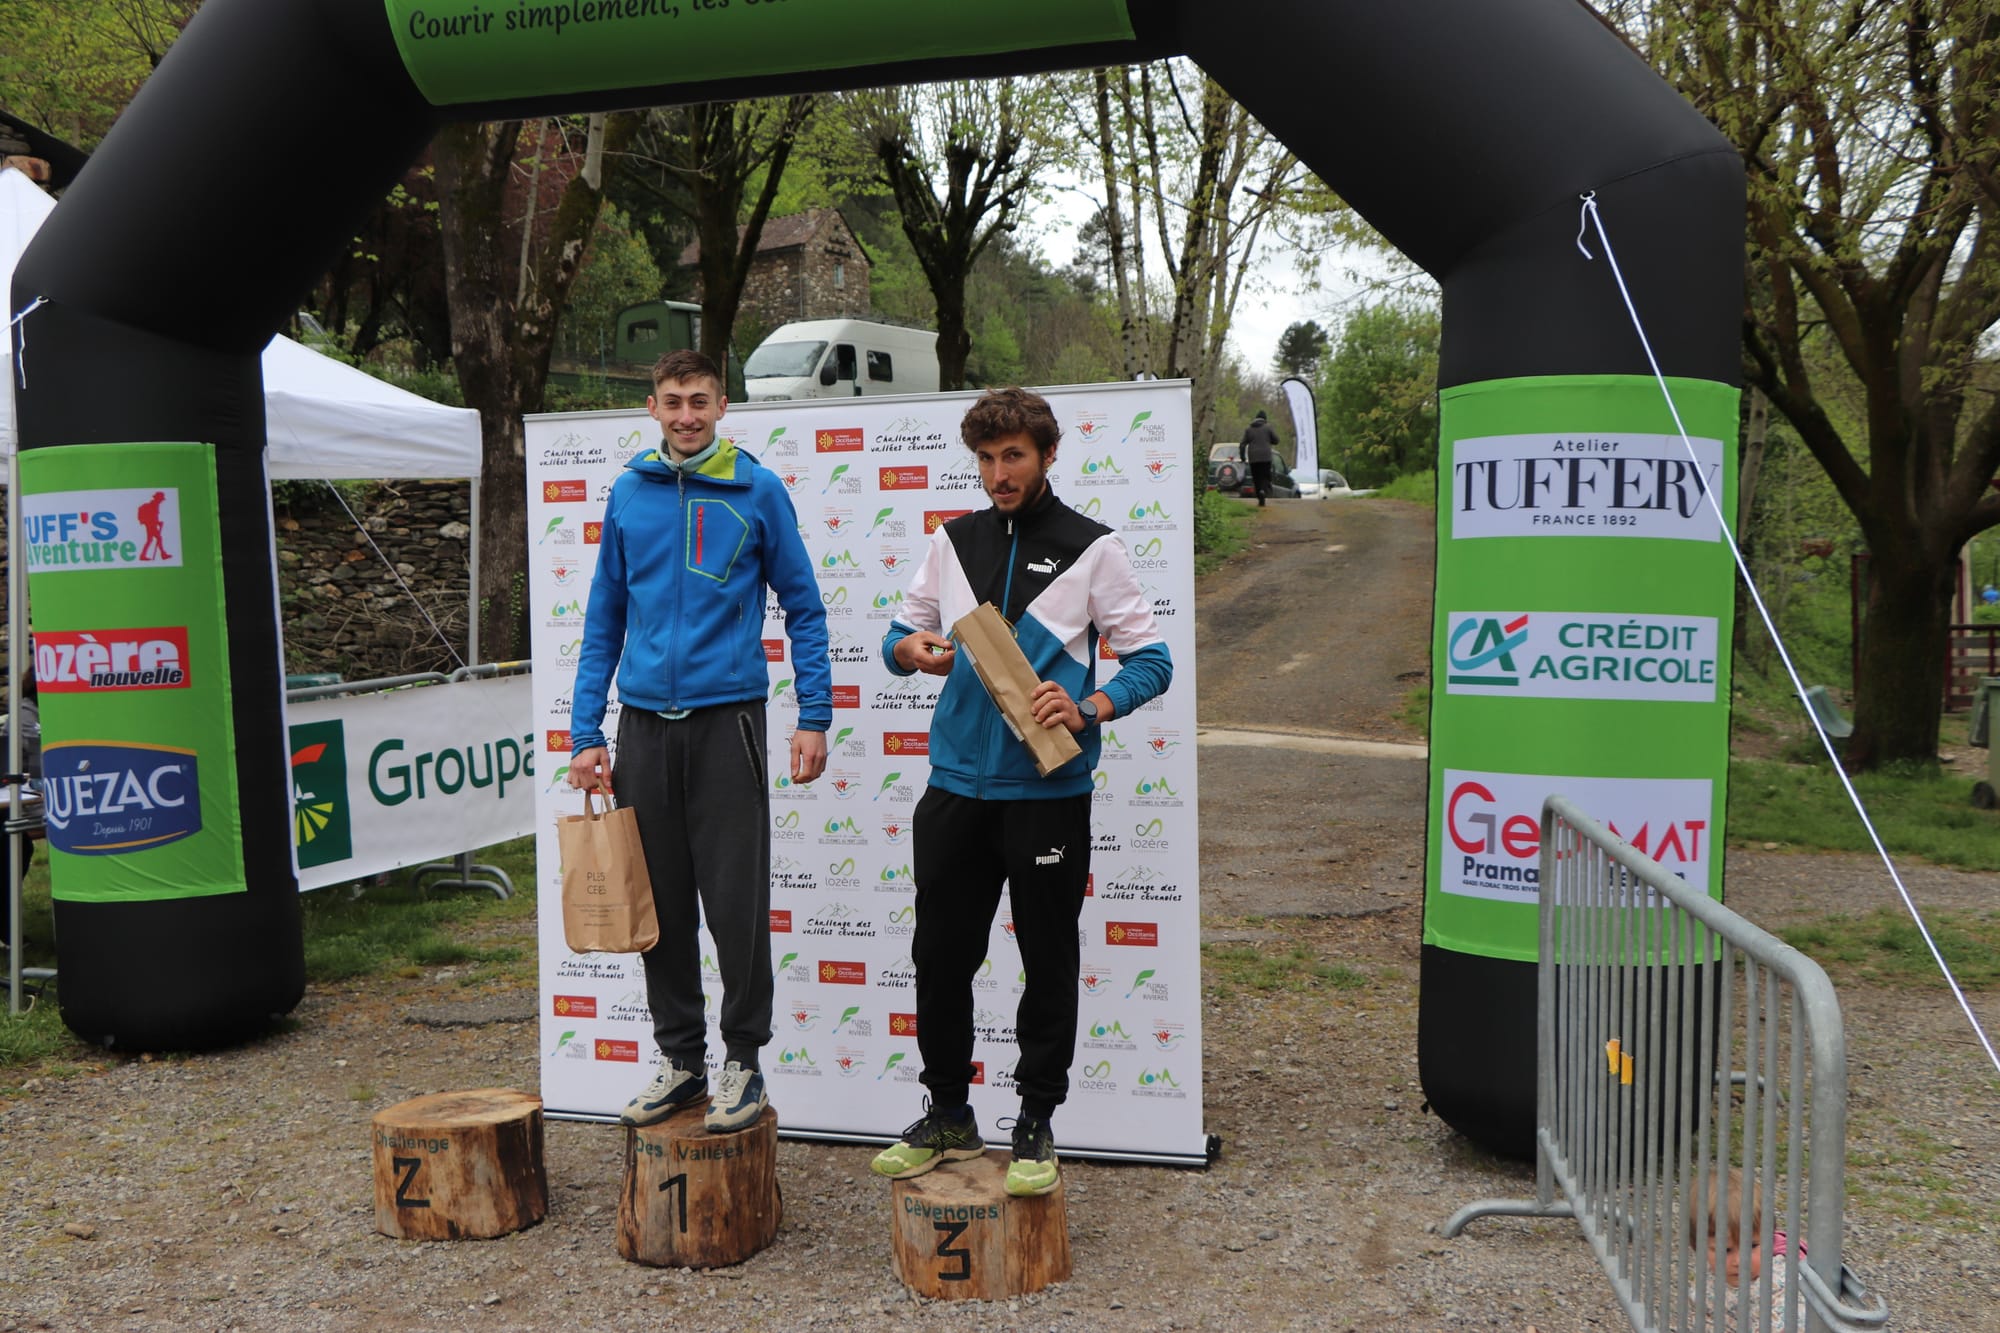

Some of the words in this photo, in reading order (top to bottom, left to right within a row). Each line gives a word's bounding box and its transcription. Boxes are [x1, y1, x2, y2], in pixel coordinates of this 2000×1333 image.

[409, 9, 494, 40] Courir
[875, 434, 920, 444] Challenge
[1553, 438, 1620, 452] Atelier
[871, 444, 902, 452] vallées
[907, 442, 947, 451] cévenoles
[1456, 458, 1719, 518] TUFFERY
[1532, 514, 1596, 526] FRANCE
[1602, 514, 1637, 526] 1892
[24, 511, 119, 544] UFF'S
[1132, 558, 1168, 569] ozère
[1558, 619, 1698, 651] CRÉDIT
[1529, 655, 1714, 684] AGRICOLE
[90, 666, 184, 688] nouvelle
[876, 692, 921, 702] Challenge
[871, 702, 902, 710] vallées
[93, 822, 127, 838] Depuis
[128, 816, 152, 832] 1901
[1100, 834, 1116, 842] des
[1130, 838, 1169, 849] lozère
[1035, 854, 1060, 866] PUMA
[825, 876, 860, 887] lozère
[1106, 882, 1155, 893] Challenge
[1101, 892, 1135, 900] vallées
[1140, 893, 1182, 902] cévenoles
[807, 918, 851, 929] Challenge
[1078, 1079, 1117, 1091] lozère
[375, 1129, 449, 1154] Challenge
[634, 1135, 663, 1158] Des
[677, 1142, 744, 1161] Vallées
[658, 1173, 687, 1233] 1
[904, 1197, 999, 1221] Cévenoles
[933, 1221, 971, 1281] 3
